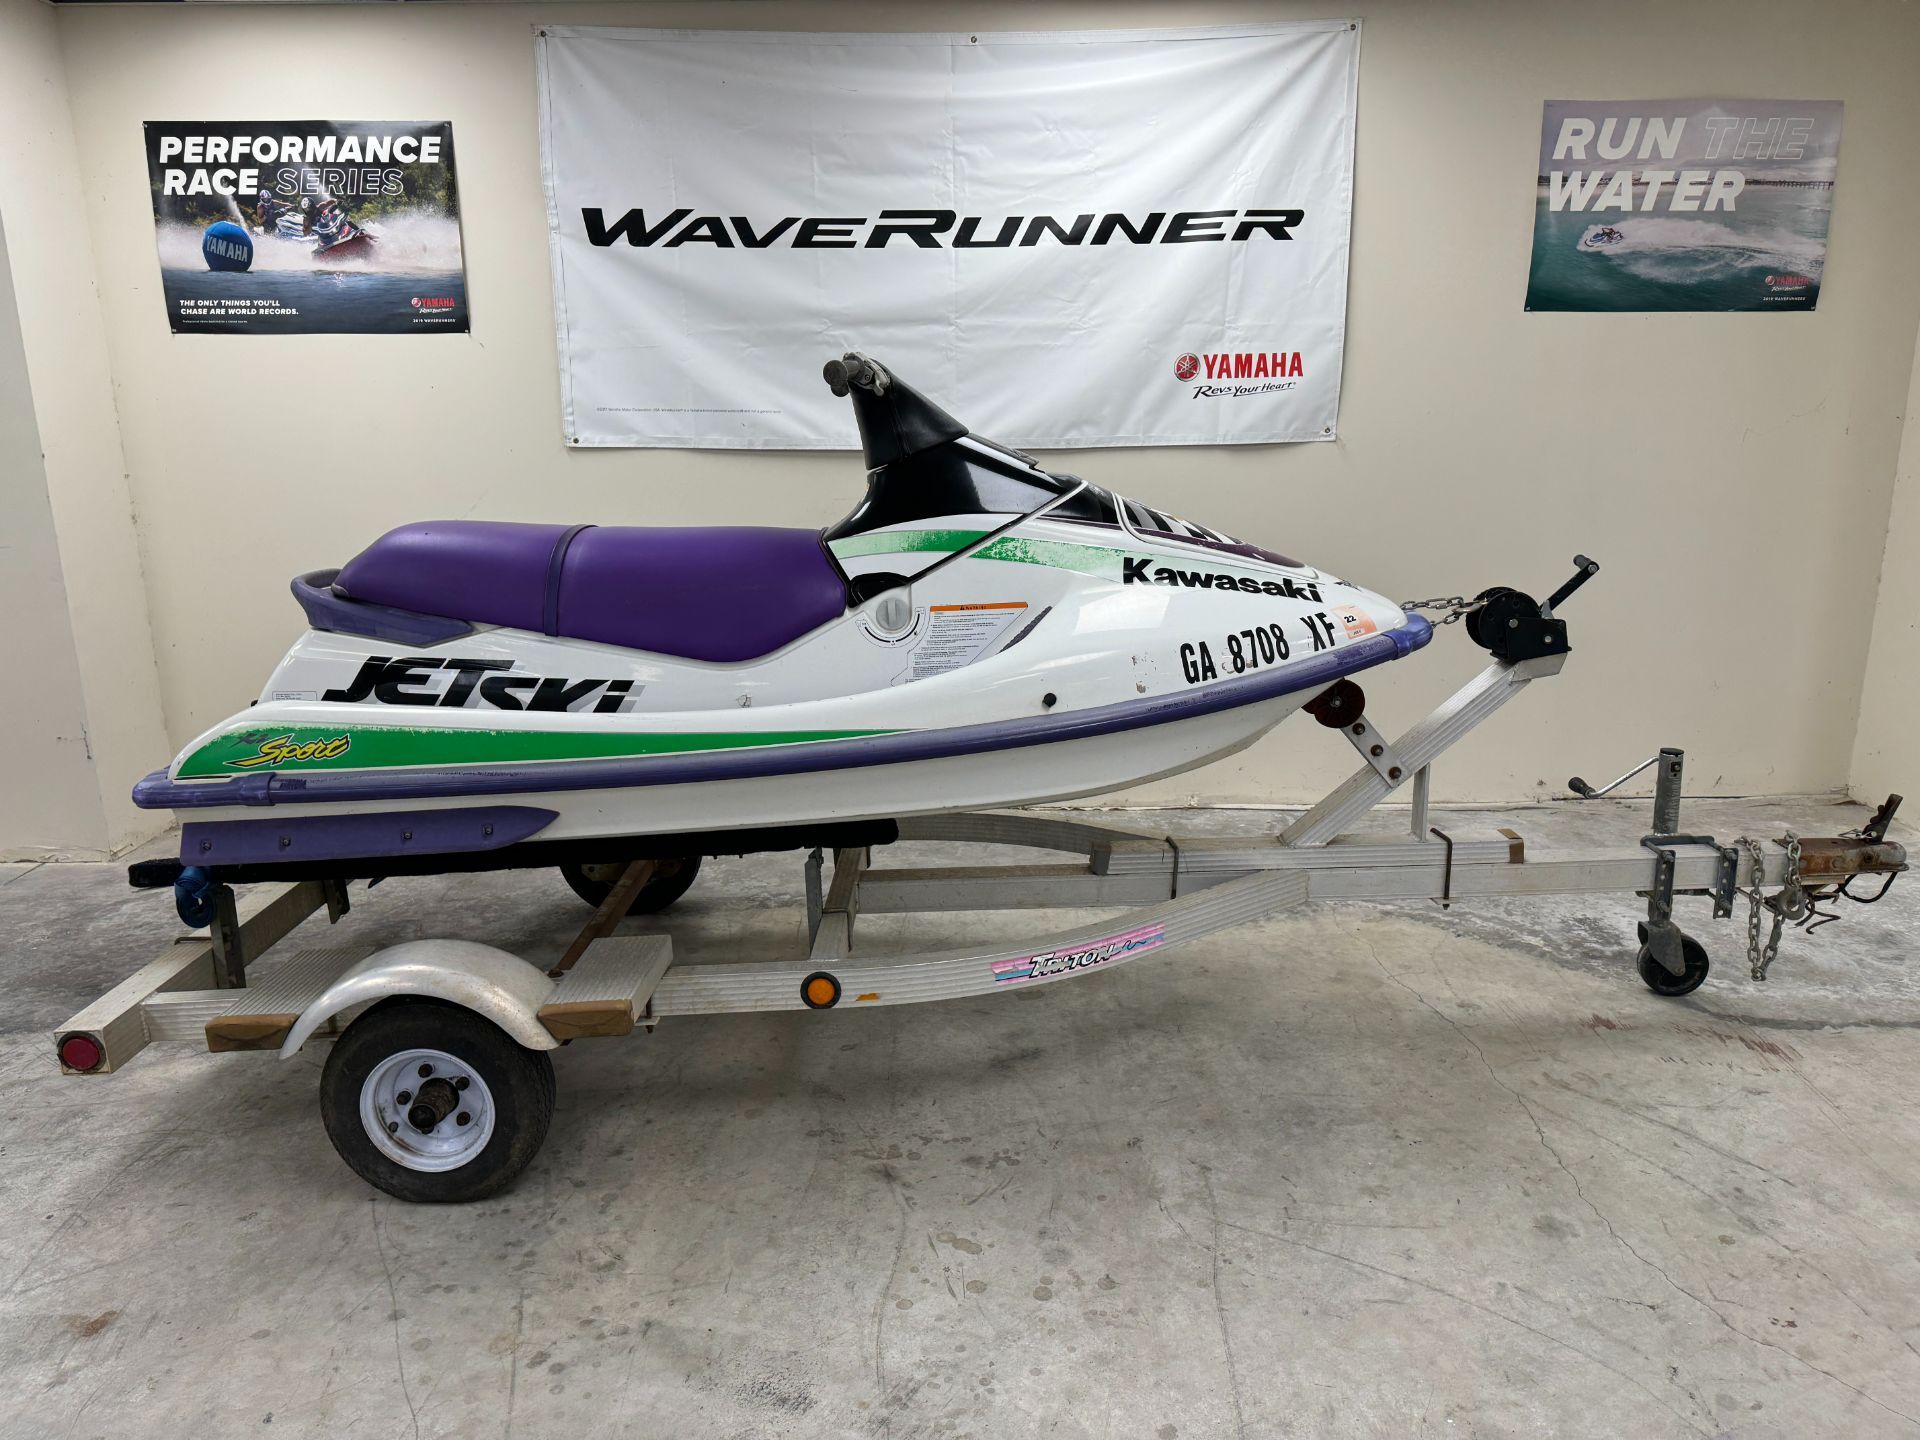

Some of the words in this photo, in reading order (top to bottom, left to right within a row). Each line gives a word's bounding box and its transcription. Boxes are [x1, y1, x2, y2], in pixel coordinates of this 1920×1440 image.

[159, 136, 441, 164] PERFORMANCE
[1551, 116, 1687, 160] RUN
[1704, 117, 1814, 160] THE
[163, 168, 259, 196] RACE
[276, 168, 404, 196] SERIES
[1549, 170, 1745, 212] WATER
[581, 208, 1305, 249] WAVERUNNER
[206, 235, 248, 263] YAMAHA
[180, 299, 196, 307] THE
[197, 299, 219, 307] ONLY
[221, 299, 252, 307] THINGS
[254, 299, 281, 307] YOU'LL
[421, 298, 454, 307] YAMAHA
[1203, 352, 1304, 380] YAMAHA
[1122, 557, 1323, 603] Kawasaki
[1343, 615, 1357, 624] 22
[1180, 641, 1218, 684] GA
[1227, 623, 1290, 675] 8708
[1299, 611, 1336, 652] XF
[222, 732, 351, 768] Sport
